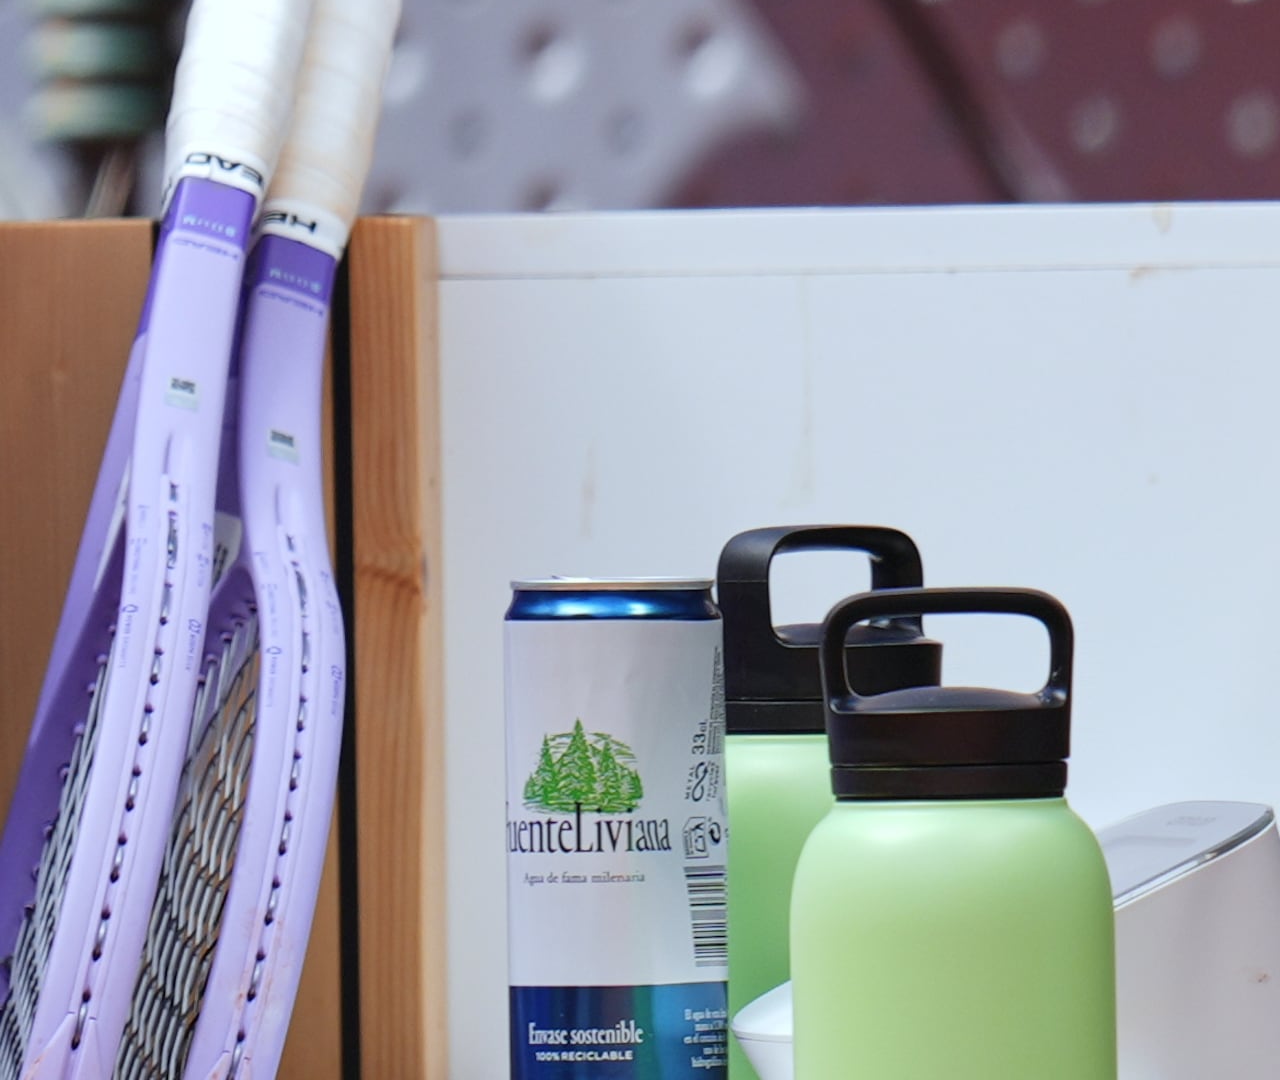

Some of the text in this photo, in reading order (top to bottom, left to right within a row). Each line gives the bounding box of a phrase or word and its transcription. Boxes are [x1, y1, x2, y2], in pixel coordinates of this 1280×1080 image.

[185, 152, 264, 188] EAD
[507, 801, 672, 853] uenteLiviana
[547, 871, 558, 884] de
[528, 1019, 644, 1045] Envase sostenible
[535, 1049, 634, 1062] 100% RECICLABLE
